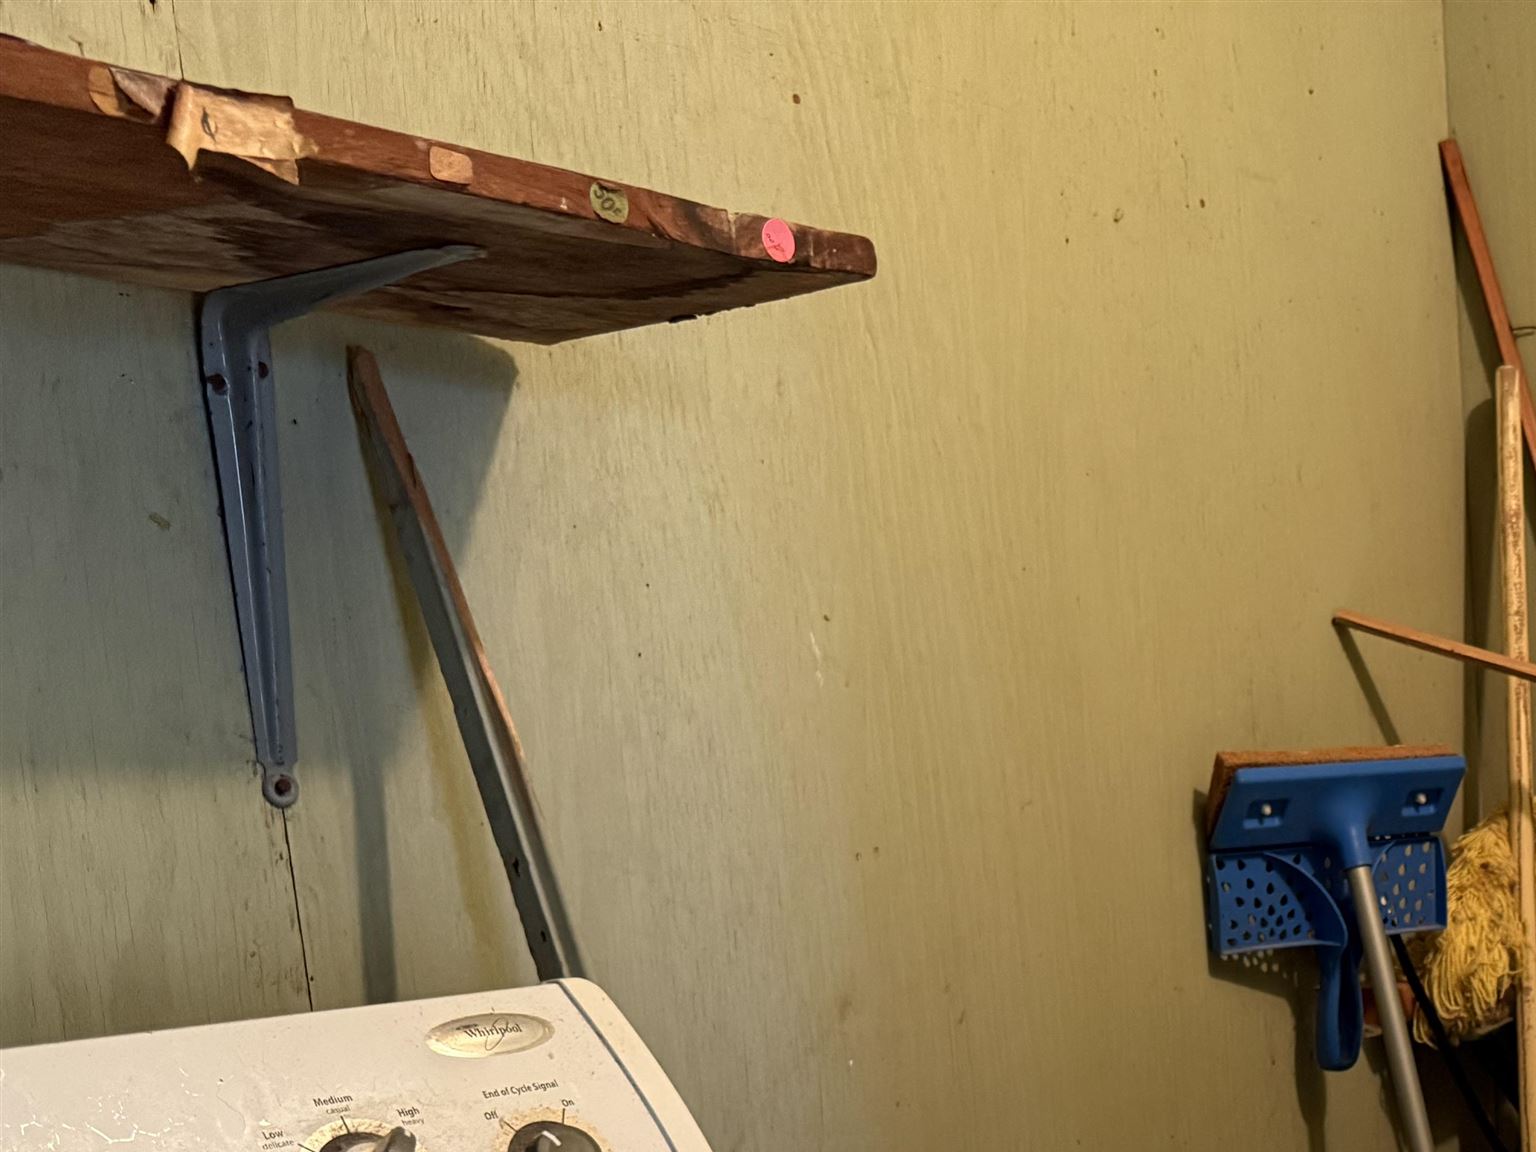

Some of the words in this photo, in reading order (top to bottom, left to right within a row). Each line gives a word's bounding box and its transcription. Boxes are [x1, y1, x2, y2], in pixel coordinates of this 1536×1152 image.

[464, 1022, 522, 1039] Whirlpool
[482, 1090, 501, 1099] End
[501, 1087, 510, 1096] of
[510, 1084, 532, 1096] Cycle
[532, 1080, 559, 1092] Signal
[313, 1094, 354, 1108] Medium
[561, 1099, 575, 1107] On
[325, 1105, 351, 1115] casual
[396, 1106, 421, 1119] High
[483, 1110, 499, 1121] Off
[261, 1129, 285, 1141] Low
[262, 1139, 295, 1151] delicate
